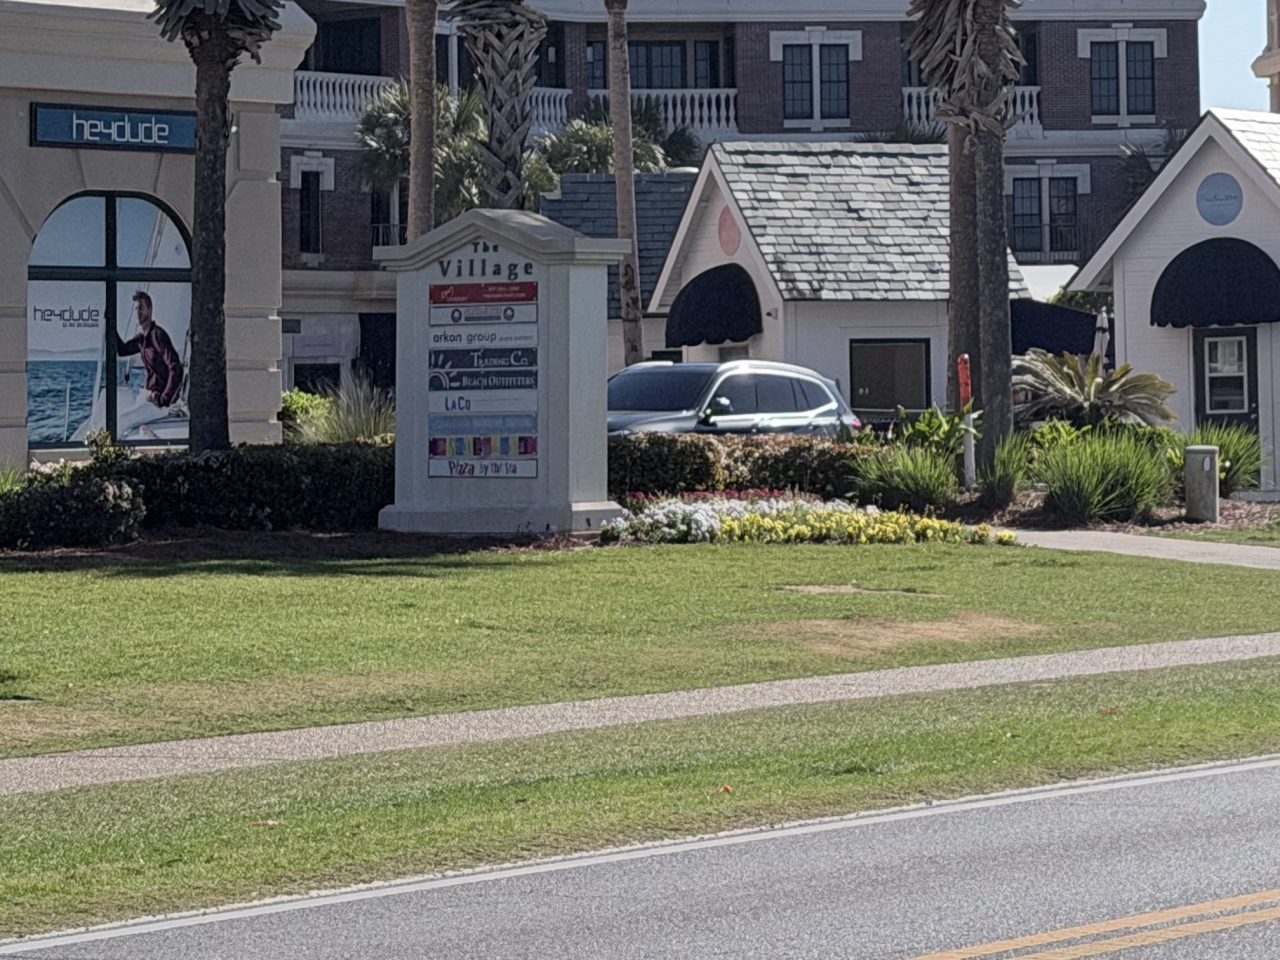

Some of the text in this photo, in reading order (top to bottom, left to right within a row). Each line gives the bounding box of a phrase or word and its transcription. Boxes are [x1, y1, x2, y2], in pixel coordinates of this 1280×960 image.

[72, 113, 169, 144] heydude
[472, 242, 499, 253] The
[438, 259, 533, 281] Village
[33, 305, 100, 321] heydude
[466, 333, 497, 344] group
